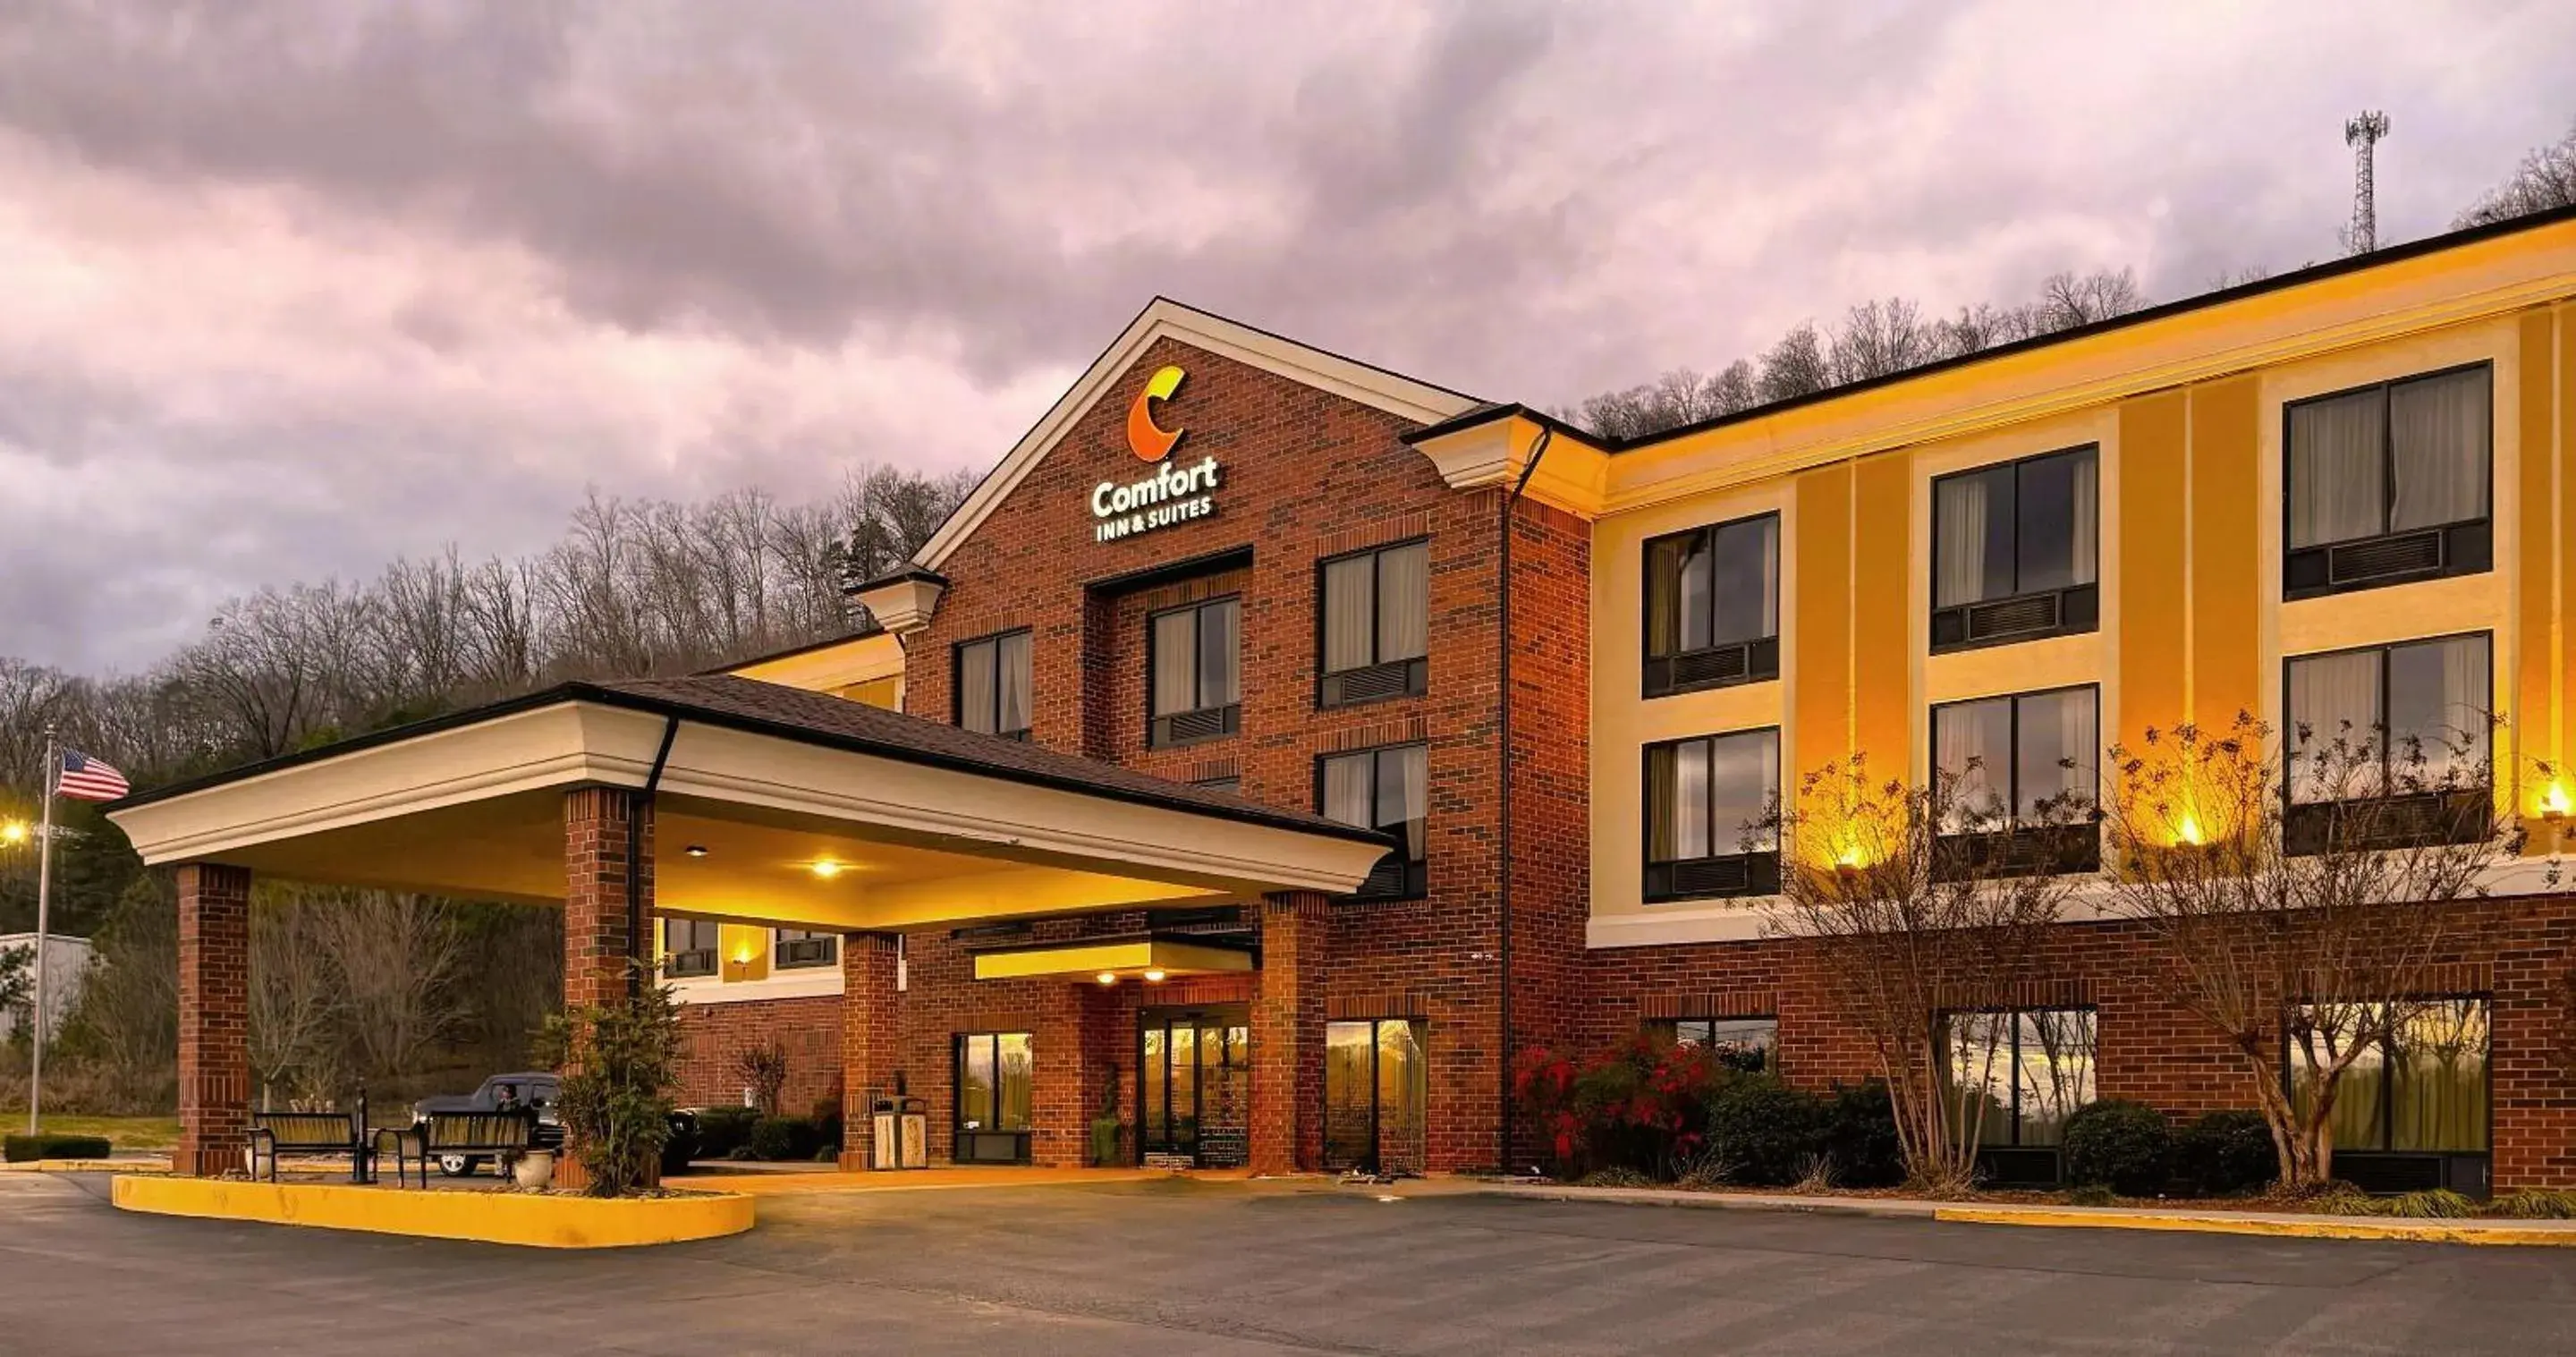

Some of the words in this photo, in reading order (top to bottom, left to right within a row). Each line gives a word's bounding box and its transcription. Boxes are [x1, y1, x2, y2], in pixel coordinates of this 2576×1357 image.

[1092, 456, 1217, 517] Comfort
[1097, 518, 1129, 542] INN
[1131, 514, 1146, 533] &
[1148, 496, 1211, 529] SUITES
